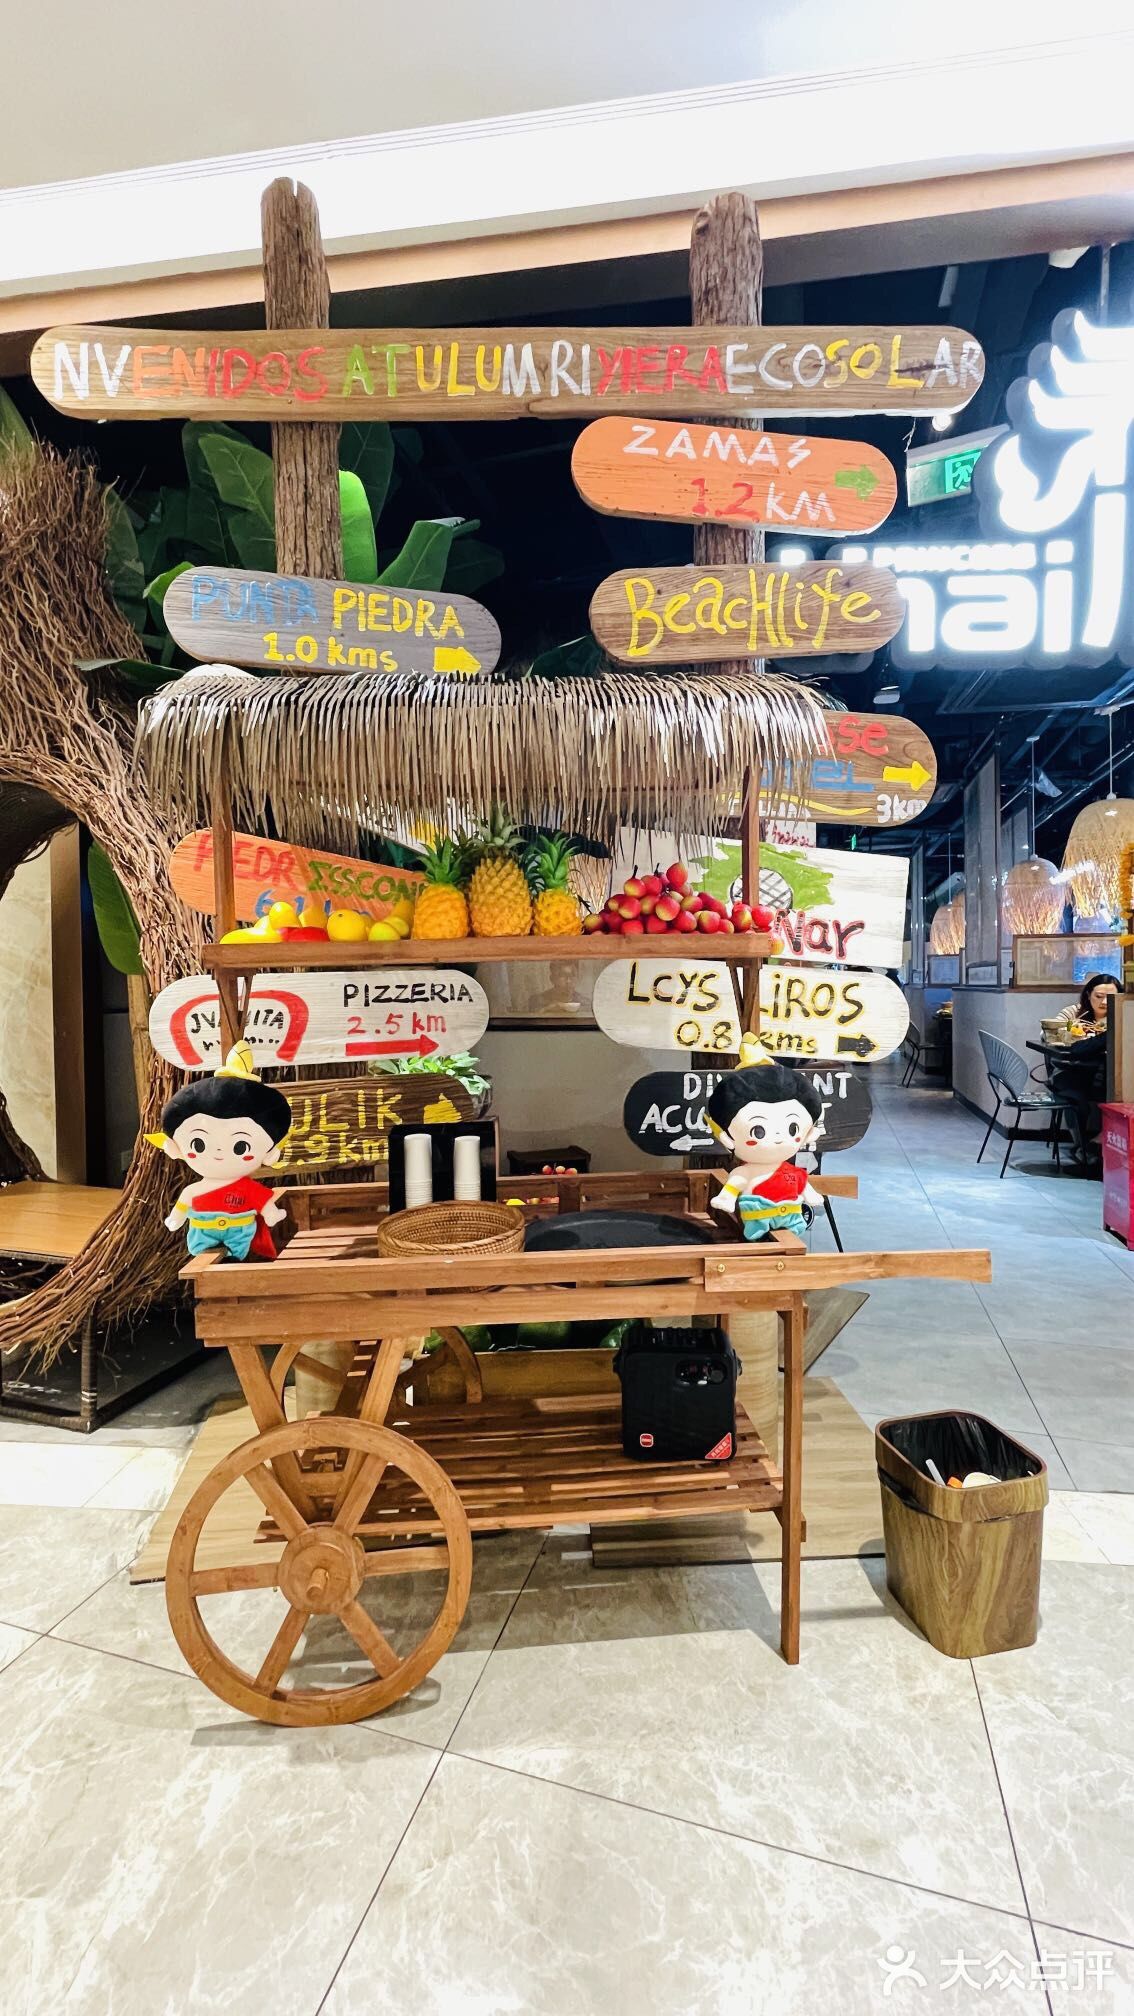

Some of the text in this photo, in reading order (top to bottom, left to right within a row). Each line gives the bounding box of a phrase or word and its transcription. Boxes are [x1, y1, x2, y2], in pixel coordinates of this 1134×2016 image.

[623, 425, 811, 470] ZAMAS
[332, 588, 465, 640] PIEDRA
[263, 632, 398, 673] 1.0 kms
[343, 983, 473, 1007] PIZZERIA
[346, 1013, 403, 1036] 2.5
[674, 1019, 734, 1051] 0.8
